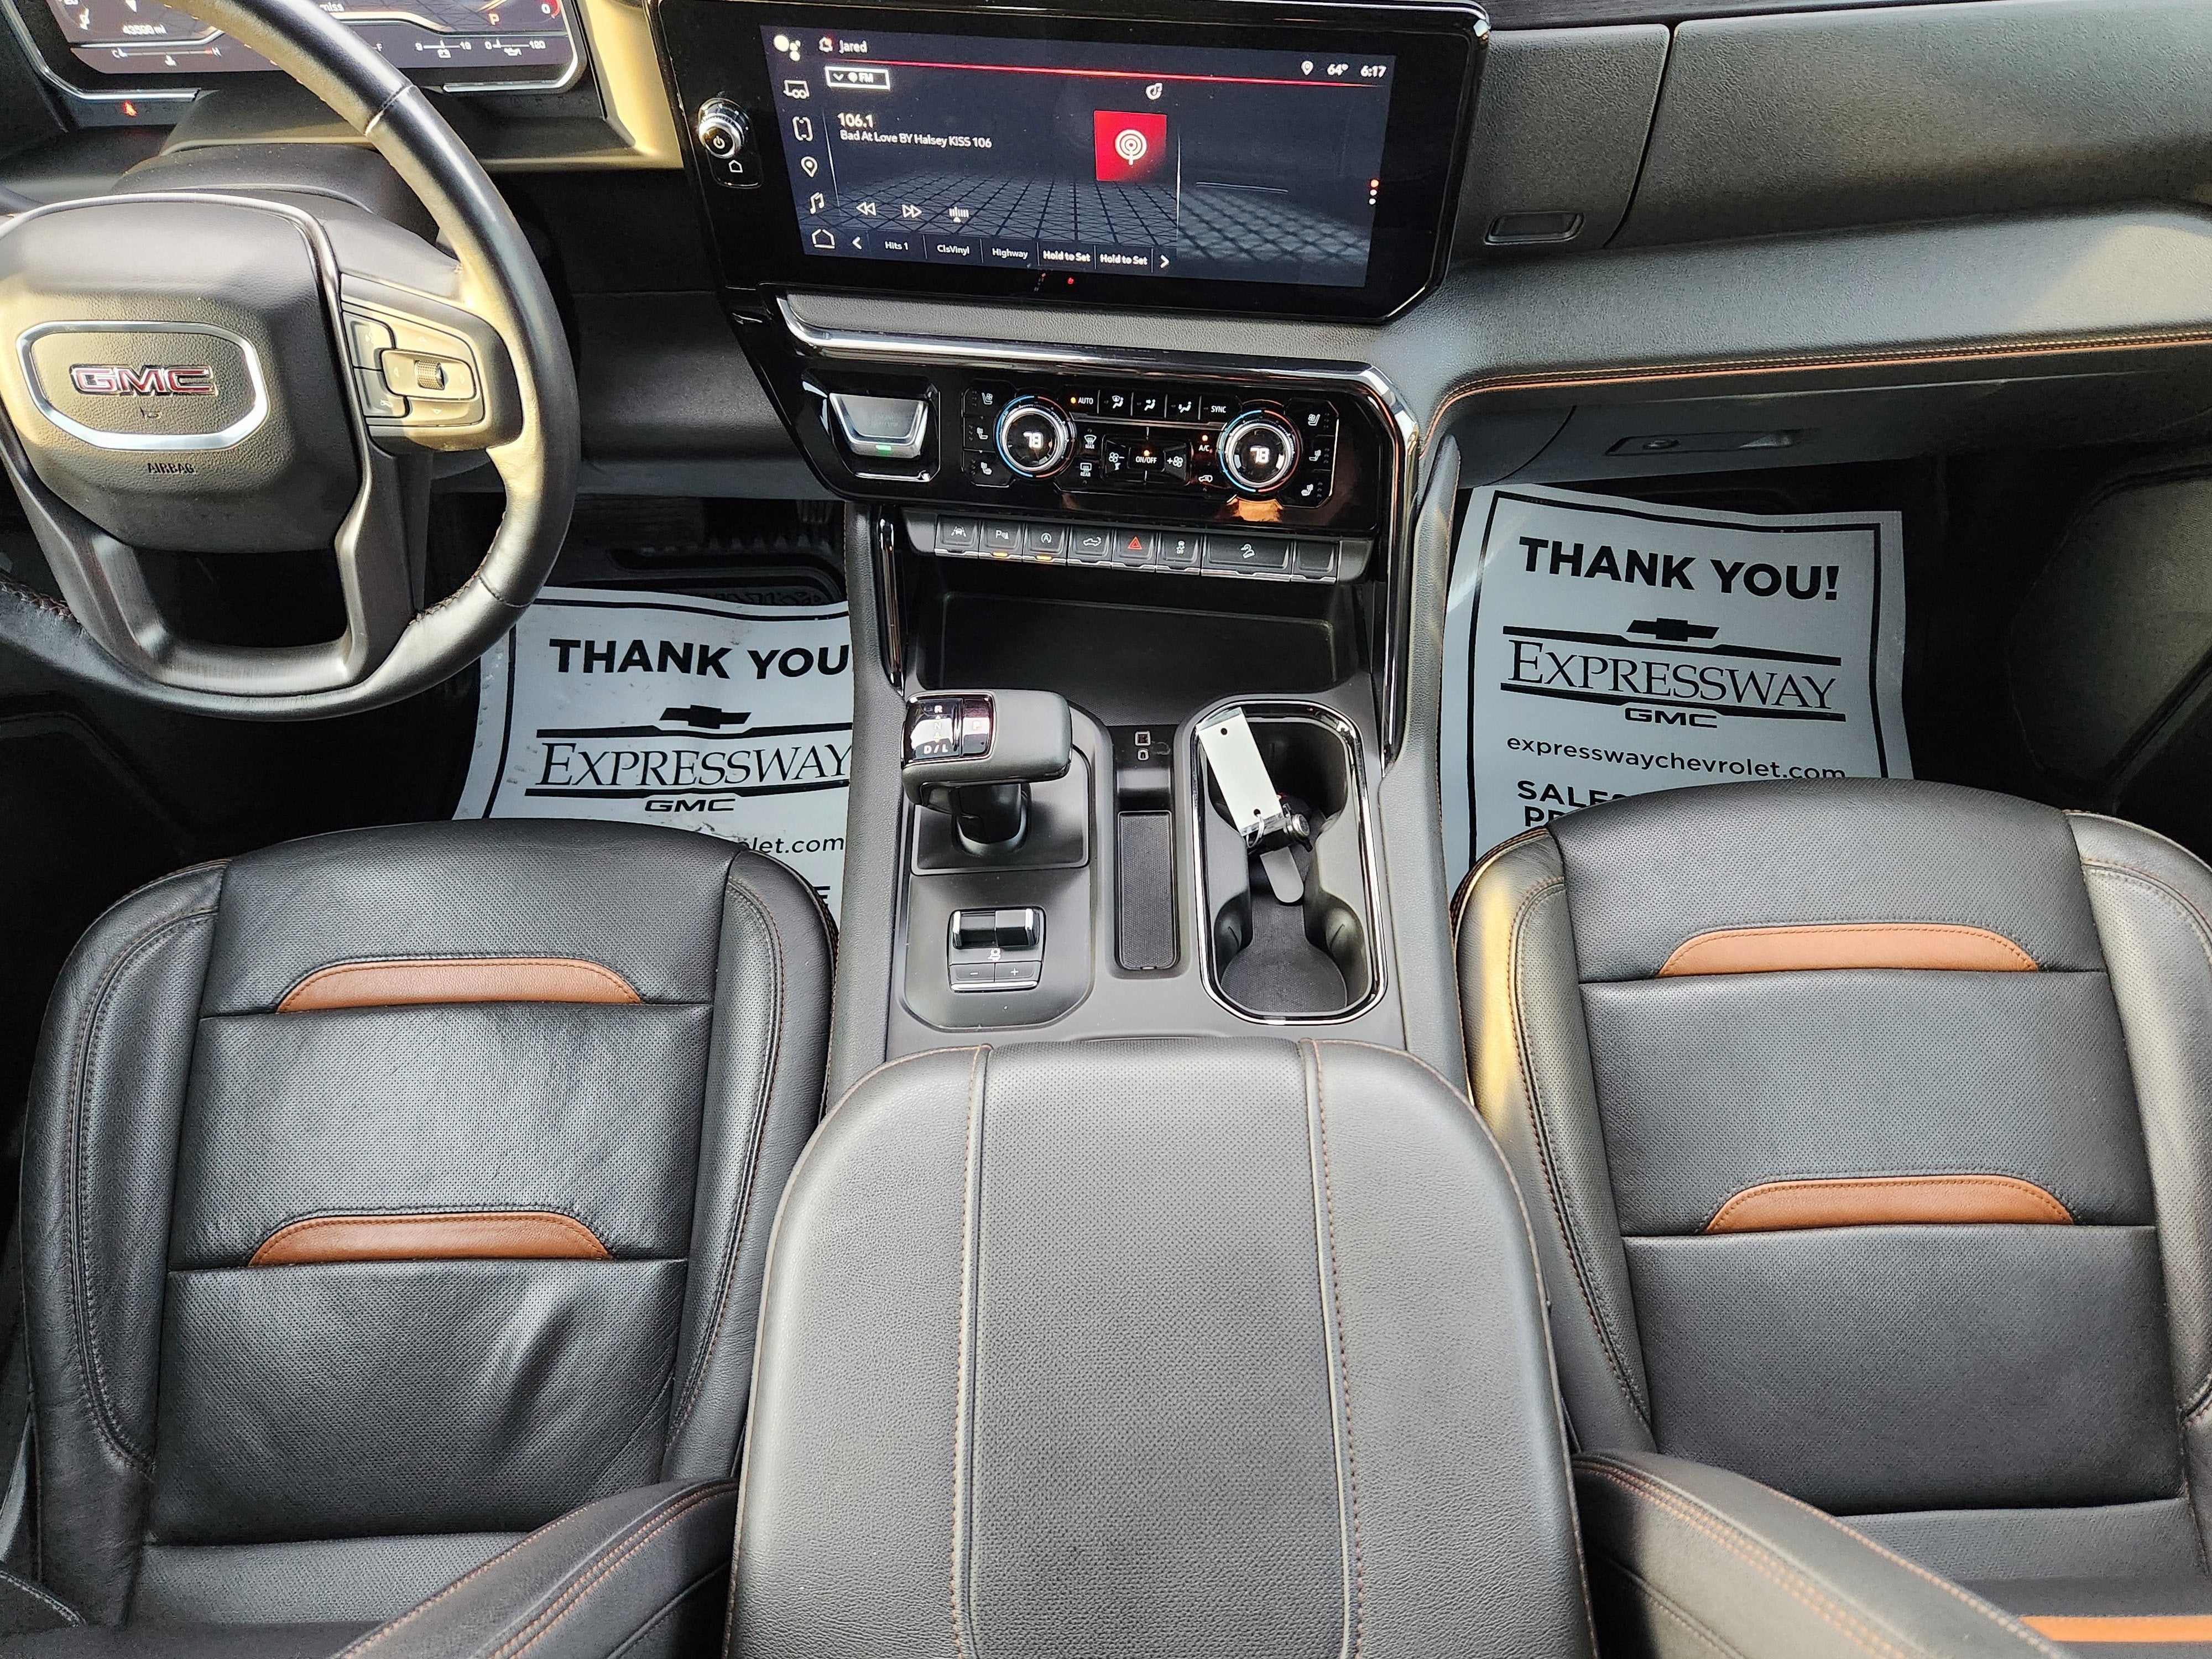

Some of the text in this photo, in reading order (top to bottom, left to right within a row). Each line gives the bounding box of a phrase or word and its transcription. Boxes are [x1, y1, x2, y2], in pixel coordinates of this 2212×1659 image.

[488, 13, 500, 25] P
[839, 40, 868, 54] Jared
[859, 73, 874, 83] FM
[1360, 65, 1387, 78] 6:17
[837, 113, 874, 128] 106.1
[839, 129, 992, 148] Bad At Love BY Halsey KISS 106
[885, 241, 902, 250] Hits
[937, 244, 970, 256] ClsVinyl
[992, 248, 1028, 259] Highway
[1042, 250, 1091, 262] Hold to Set
[1100, 253, 1148, 265] Hold to Set
[70, 363, 218, 397] GMC
[1023, 431, 1044, 448] 78
[1250, 447, 1270, 463] 78
[148, 462, 195, 474] AIRBAG
[1519, 536, 1840, 601] THANK YOU!
[549, 638, 850, 680] THANK YOU
[1507, 639, 1837, 709] EXPRESSWAY
[1625, 707, 1718, 729] GMC
[973, 721, 980, 730] P
[535, 742, 852, 786] EXPRESSWAY
[1506, 737, 1846, 779] expresswaychevrolet.com
[1517, 780, 1630, 808] SALE
[645, 798, 736, 812] GMC
